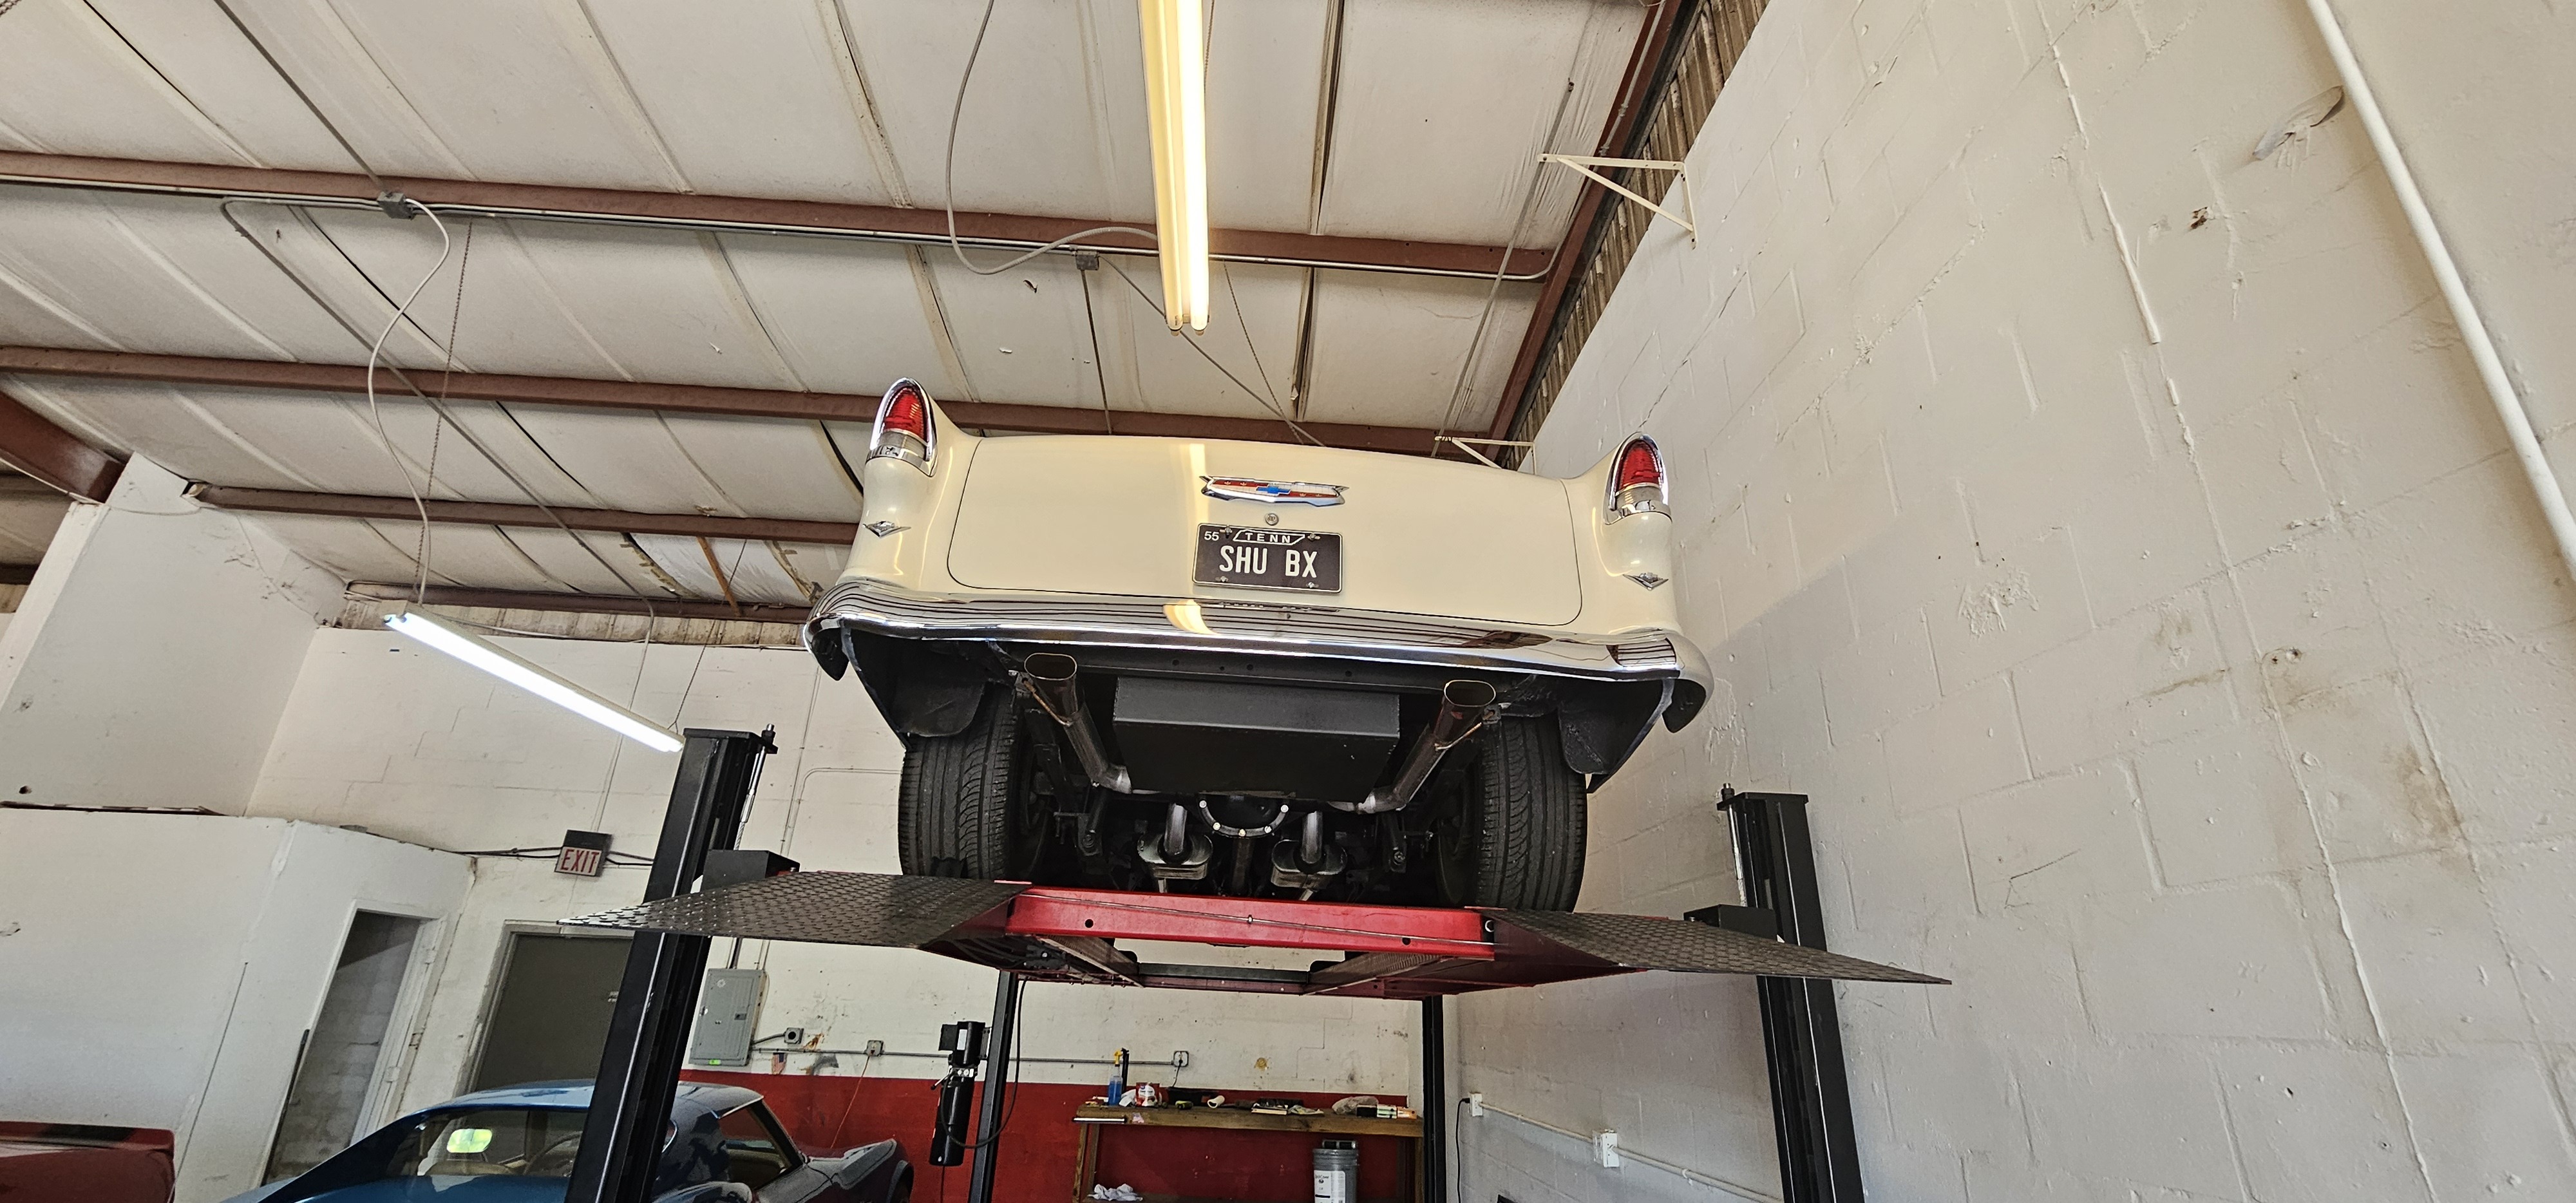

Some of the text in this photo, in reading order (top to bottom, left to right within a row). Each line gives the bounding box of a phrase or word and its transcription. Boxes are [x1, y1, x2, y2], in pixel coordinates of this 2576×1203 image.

[1204, 531, 1219, 541] 55
[1245, 532, 1291, 543] TENN
[1220, 545, 1317, 578] SHU BX
[561, 849, 599, 873] EXIT
